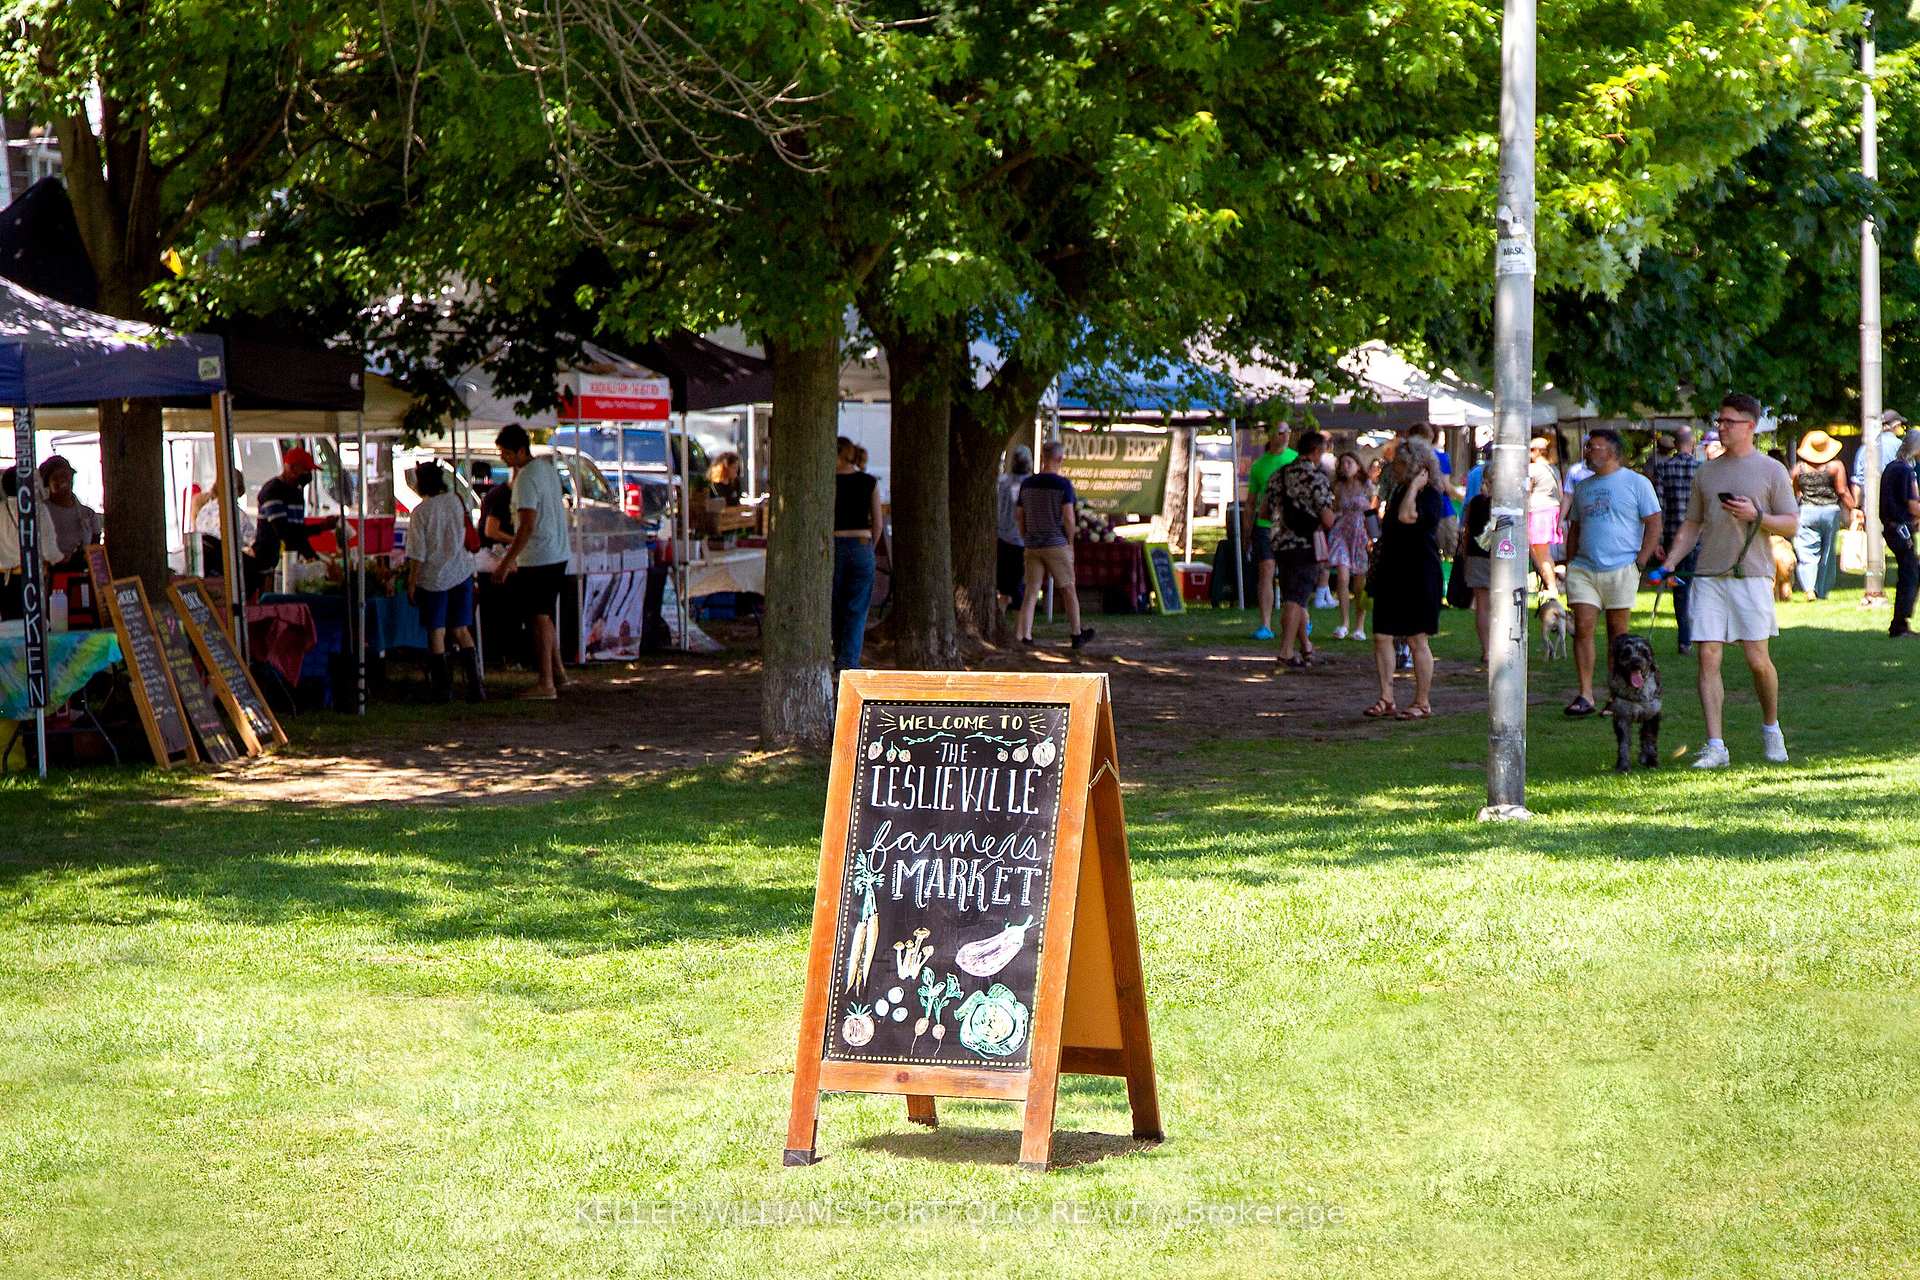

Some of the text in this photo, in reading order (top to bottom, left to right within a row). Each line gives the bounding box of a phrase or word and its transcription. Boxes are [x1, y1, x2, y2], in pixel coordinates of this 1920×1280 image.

[17, 486, 46, 708] CHICKEN
[899, 714, 1023, 730] WELCOME TO
[871, 764, 1042, 815] LESLIEVILLE
[891, 858, 1043, 912] MARKET
